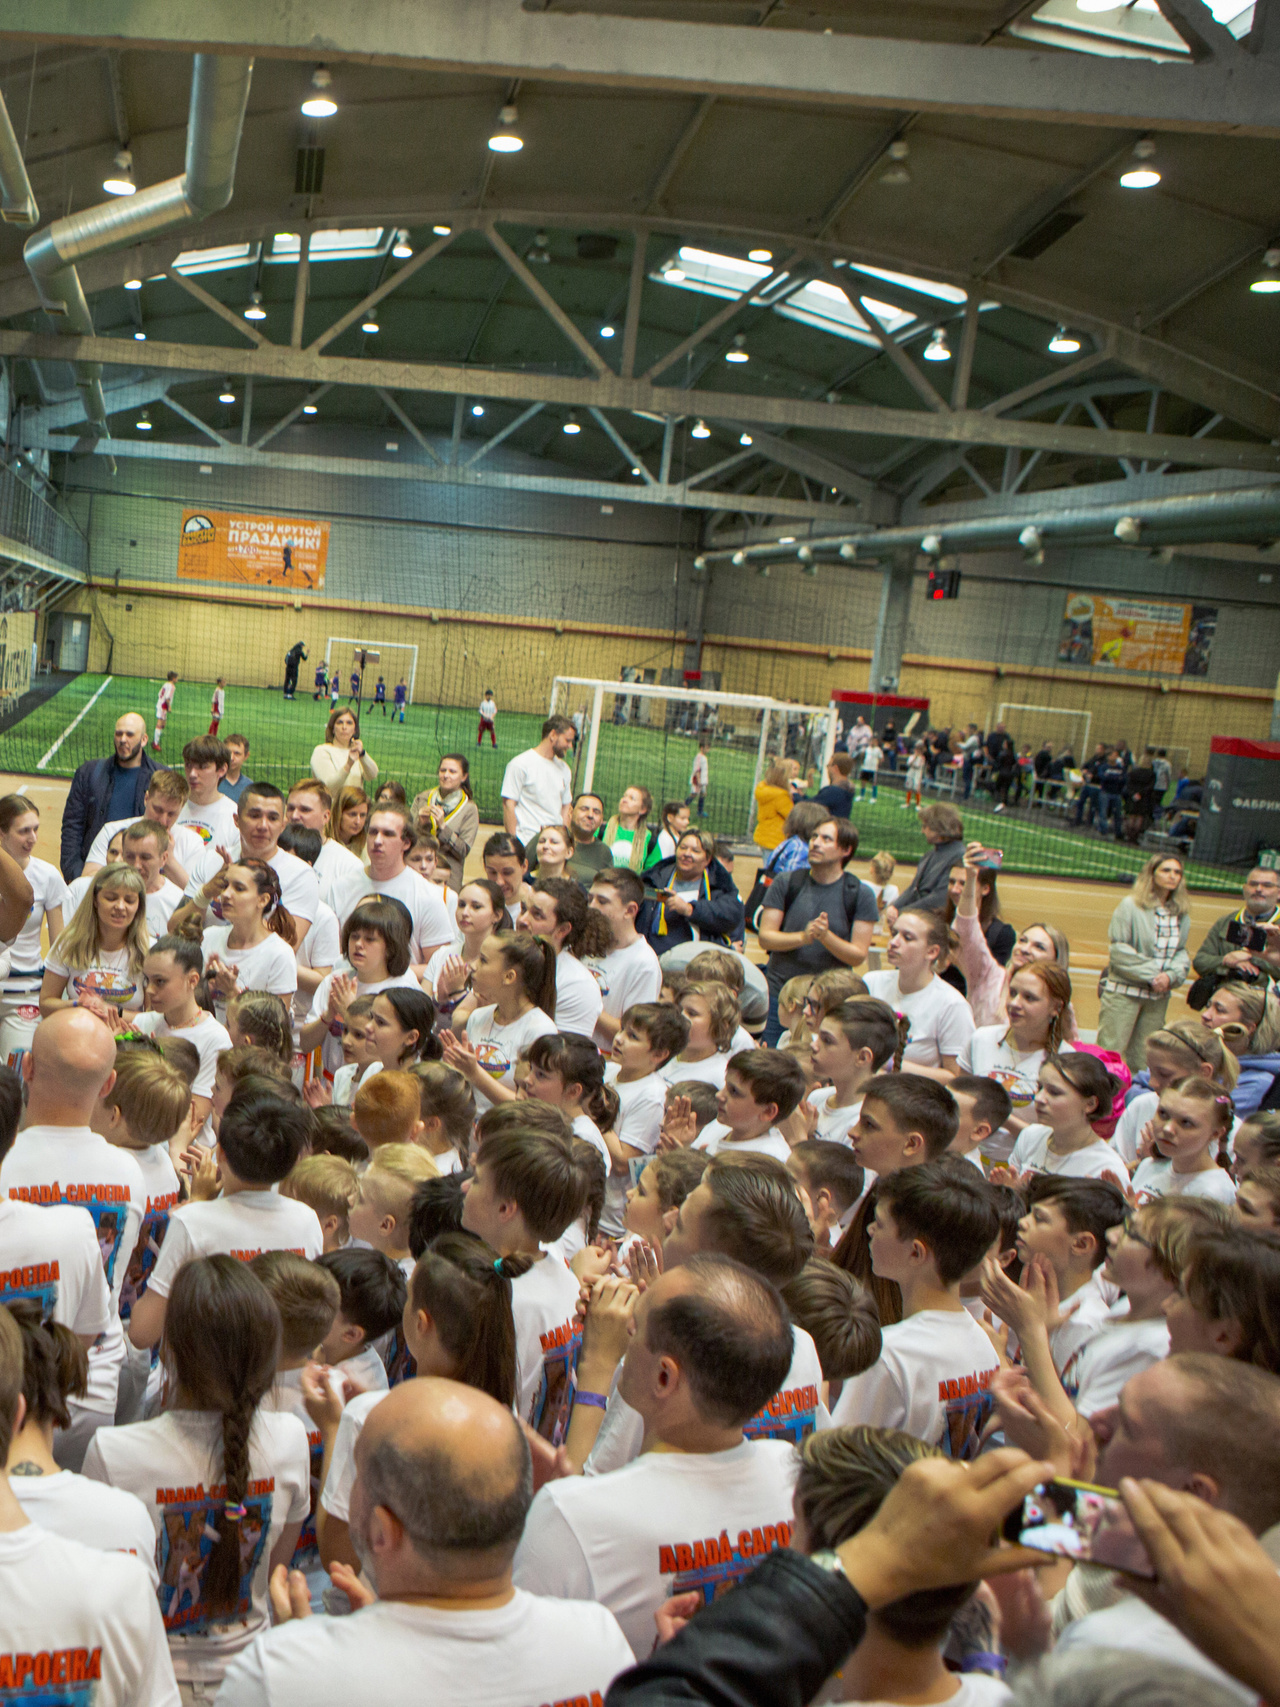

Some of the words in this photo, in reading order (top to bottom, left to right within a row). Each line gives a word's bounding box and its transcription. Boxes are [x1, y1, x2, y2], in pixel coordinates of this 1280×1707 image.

[229, 519, 274, 533] УСТРОЙ
[277, 524, 321, 537] КРУТОЙ
[659, 1520, 794, 1574] ABADÁ-CAPO
